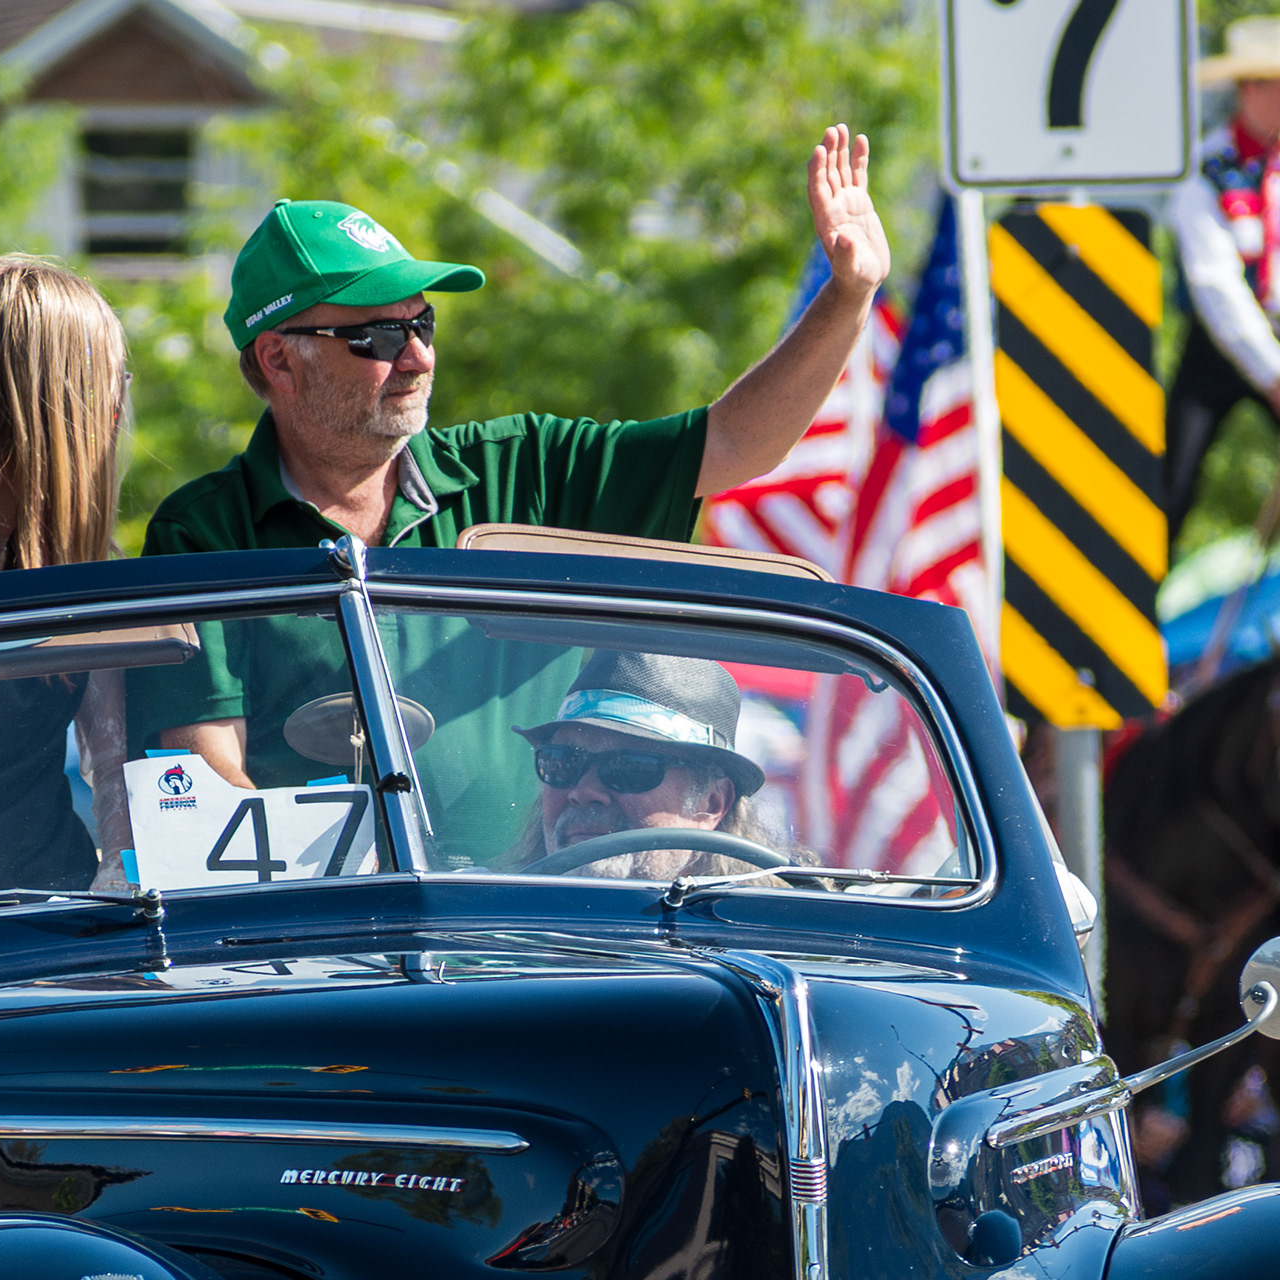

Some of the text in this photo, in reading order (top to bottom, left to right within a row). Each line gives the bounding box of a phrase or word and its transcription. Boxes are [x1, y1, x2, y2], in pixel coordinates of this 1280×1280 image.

[245, 293, 293, 328] UTAH VALLEY
[206, 790, 369, 882] 47
[280, 1169, 465, 1192] MERCURY EIGHT
